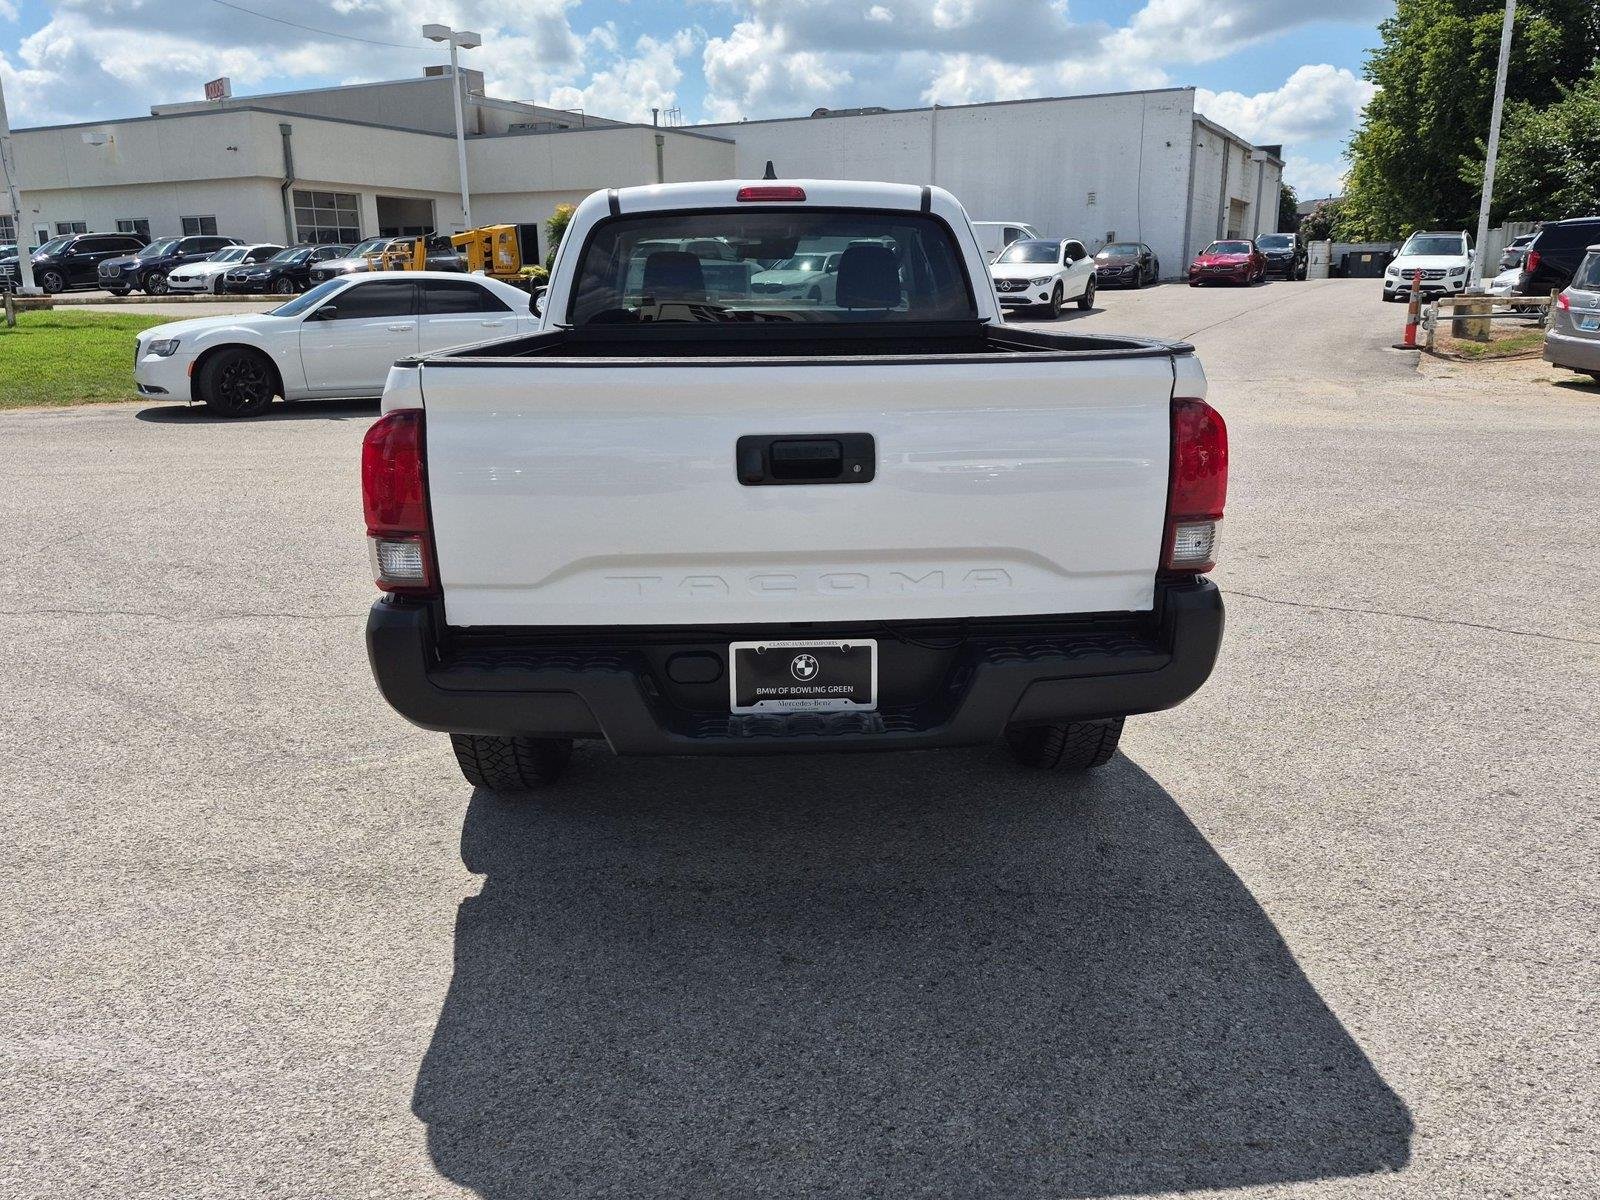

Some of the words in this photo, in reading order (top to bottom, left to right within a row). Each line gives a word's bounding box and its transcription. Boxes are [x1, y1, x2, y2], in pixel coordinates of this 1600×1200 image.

[603, 568, 1013, 597] TACOMA
[756, 687, 776, 695] BMW
[778, 687, 788, 695] OF
[790, 686, 826, 694] BOWLING
[828, 685, 853, 693] GREEN
